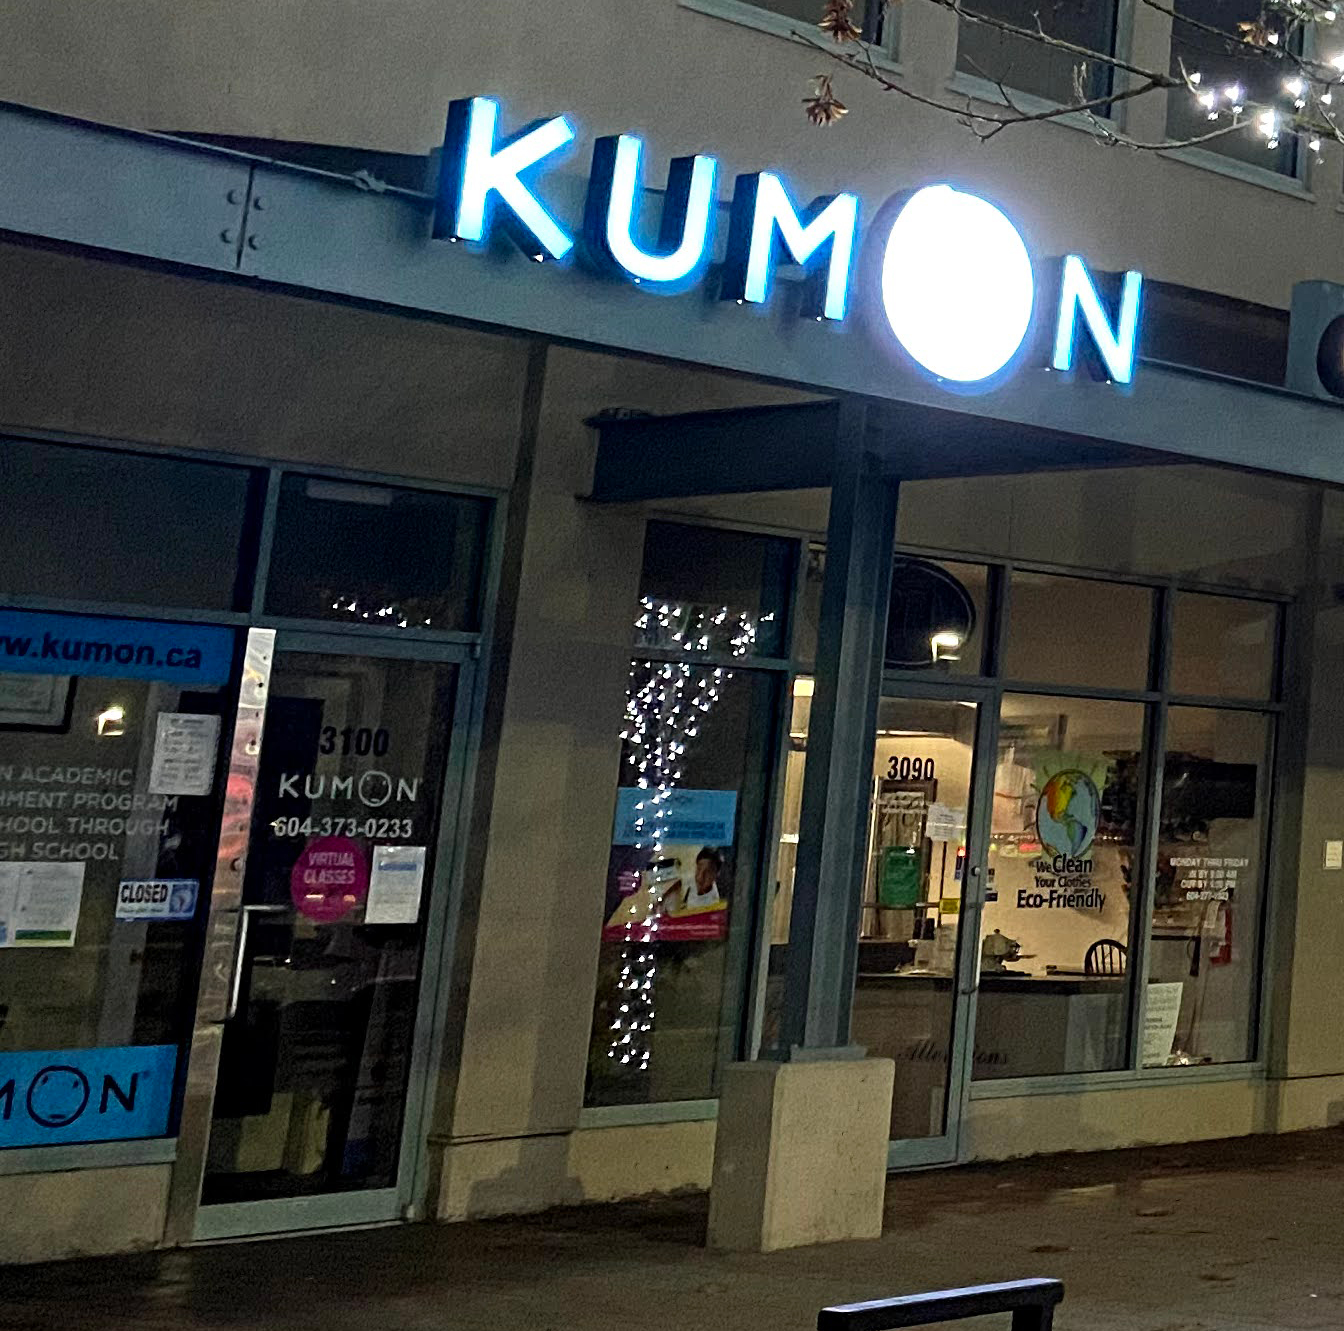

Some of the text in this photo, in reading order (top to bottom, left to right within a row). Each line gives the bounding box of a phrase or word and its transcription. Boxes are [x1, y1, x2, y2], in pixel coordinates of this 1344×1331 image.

[440, 96, 1144, 384] KUMON
[319, 725, 390, 757] 3100
[21, 766, 134, 786] ACADEMIC
[887, 755, 935, 781] 3090
[277, 769, 419, 808] KUMON
[71, 792, 179, 813] PROGRAM
[67, 817, 171, 837] THROUGH
[273, 816, 413, 838] 604-373-0233
[32, 842, 119, 861] SCHOOL
[308, 851, 355, 867] VIRTUAL
[1053, 853, 1093, 873] Clean
[303, 869, 356, 885] CLASSES
[1034, 876, 1091, 888] Your Clothes
[121, 884, 168, 903] CLOSED
[1017, 888, 1106, 913] Eco-Friendly
